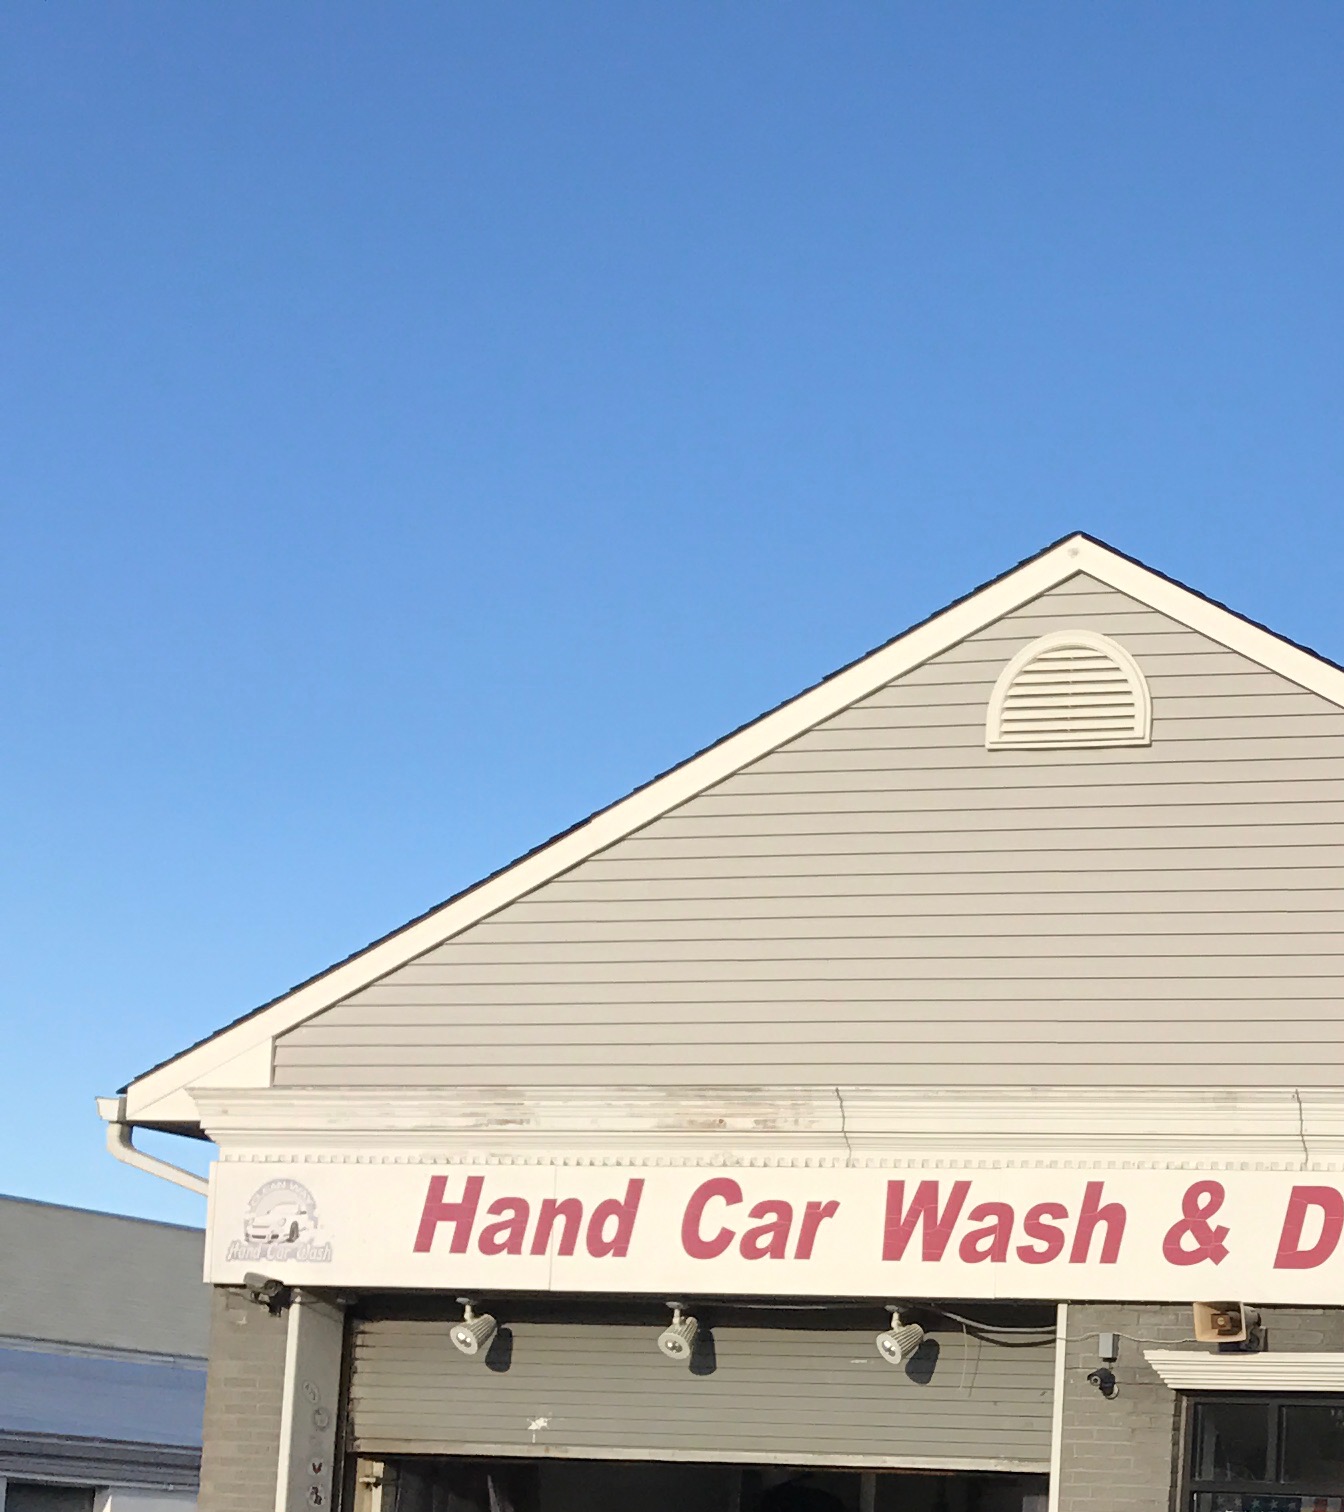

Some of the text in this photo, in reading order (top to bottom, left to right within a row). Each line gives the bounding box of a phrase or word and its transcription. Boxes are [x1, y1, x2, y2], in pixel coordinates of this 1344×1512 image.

[413, 1175, 645, 1258] Hand
[681, 1177, 840, 1260] Car
[882, 1180, 1128, 1264] Wash
[1162, 1180, 1229, 1266] &
